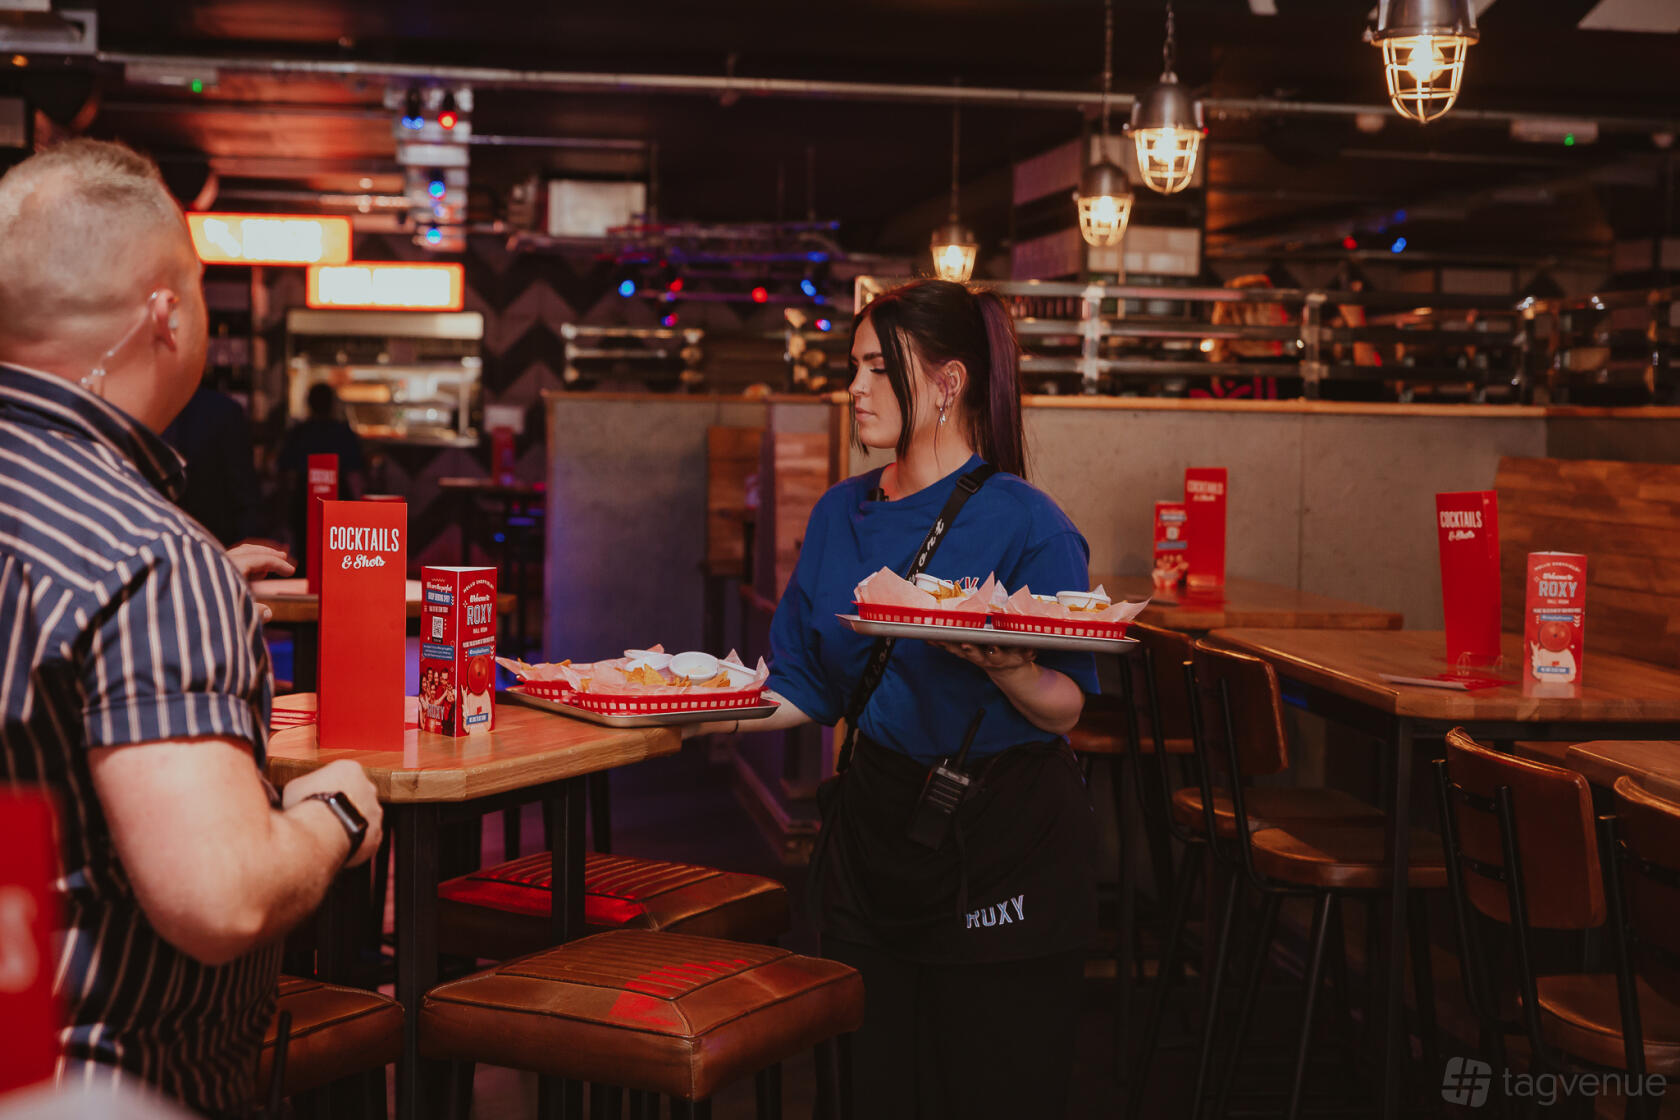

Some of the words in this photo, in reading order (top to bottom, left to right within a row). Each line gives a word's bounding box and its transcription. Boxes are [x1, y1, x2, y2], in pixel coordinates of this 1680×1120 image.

[1440, 510, 1483, 528] COCKTAILS
[329, 526, 400, 552] COCKTAILS
[341, 555, 353, 570] &
[353, 554, 386, 569] Shots
[1538, 581, 1578, 598] ROXY
[466, 603, 493, 626] ROXY
